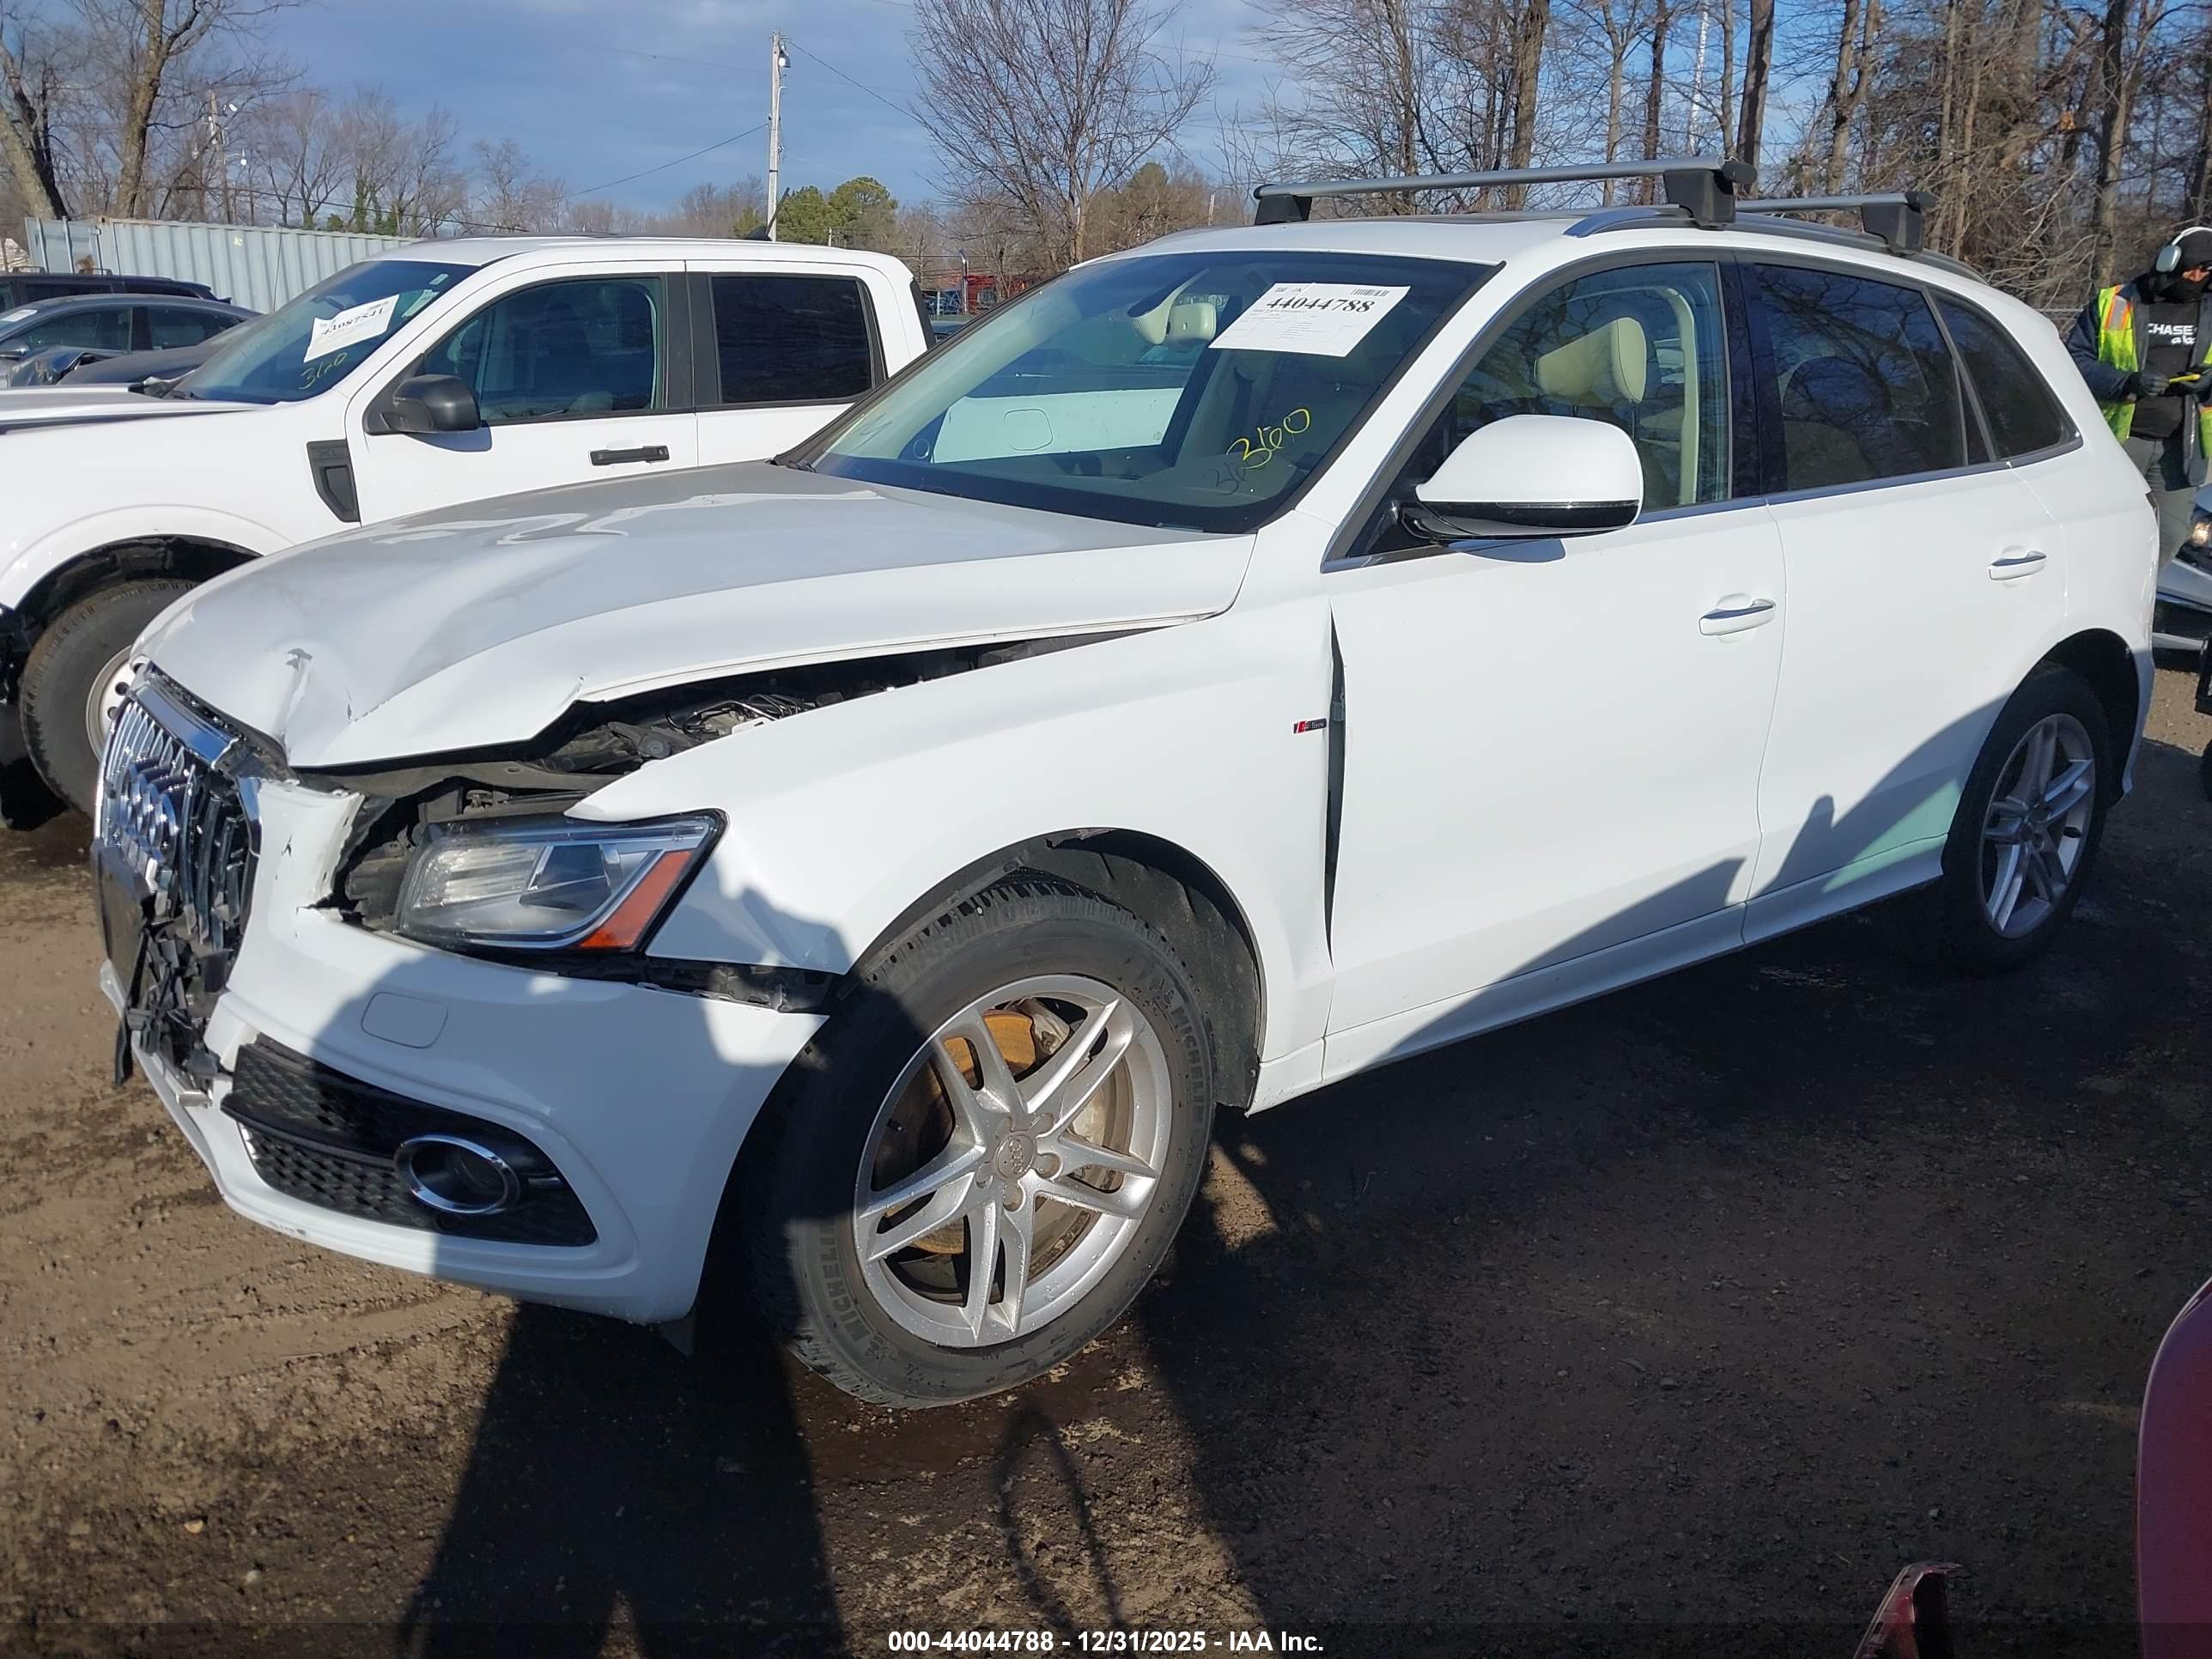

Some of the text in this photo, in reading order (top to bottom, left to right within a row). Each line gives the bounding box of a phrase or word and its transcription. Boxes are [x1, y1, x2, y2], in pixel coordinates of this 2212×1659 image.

[1267, 296, 1376, 313] 44044788
[298, 351, 348, 390] 360
[1225, 408, 1311, 469] 360
